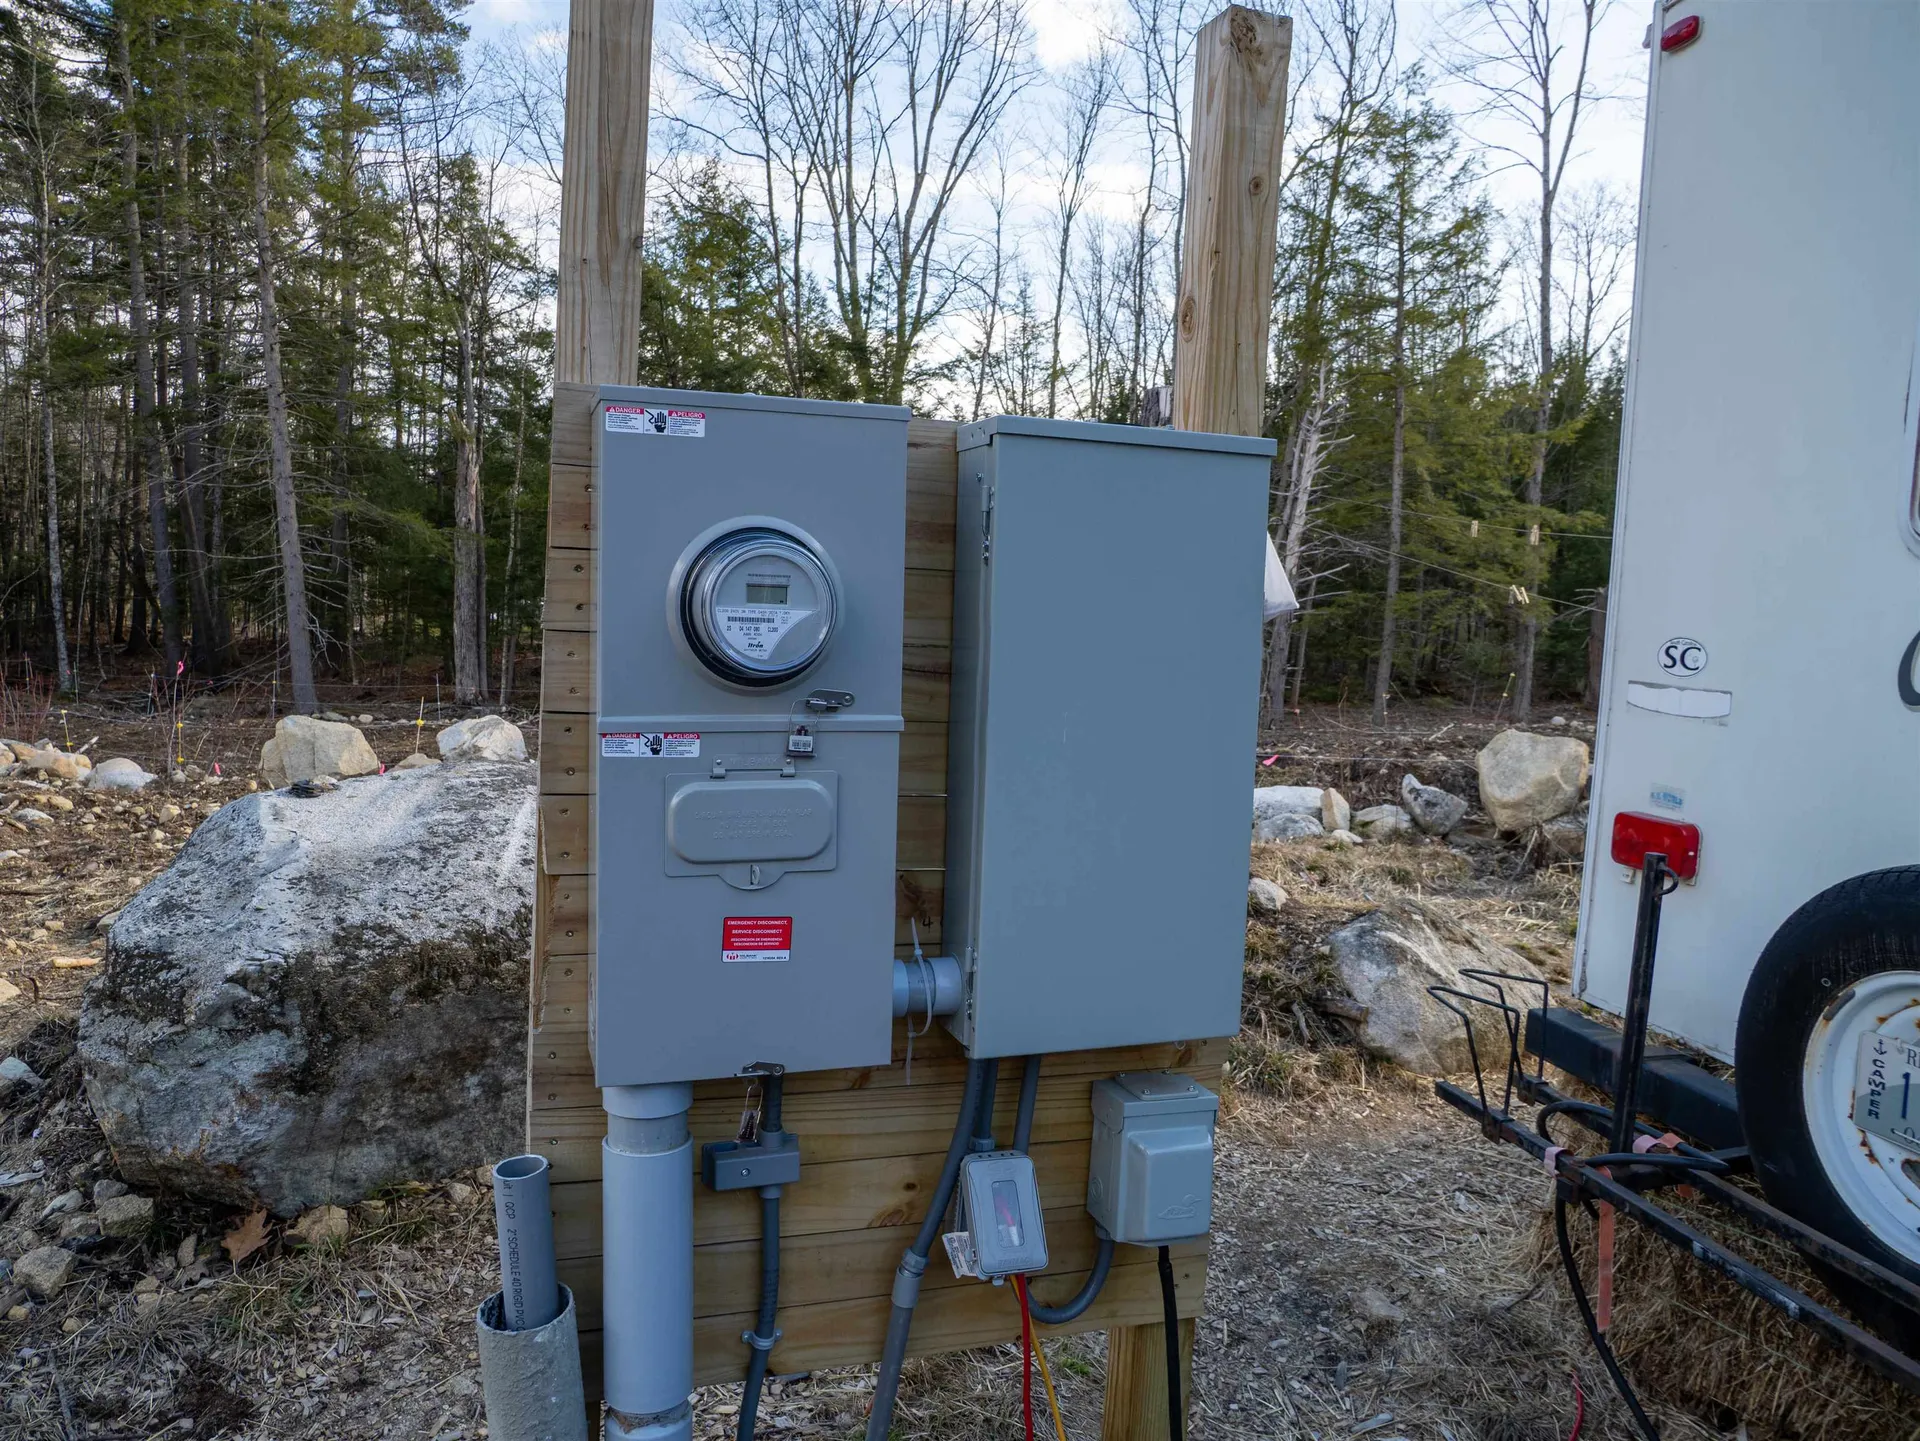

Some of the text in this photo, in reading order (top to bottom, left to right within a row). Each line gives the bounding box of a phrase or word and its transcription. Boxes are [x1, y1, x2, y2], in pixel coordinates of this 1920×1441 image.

[677, 411, 703, 419] PELIGRO
[1663, 645, 1702, 671] SC
[1867, 1058, 1886, 1120] CAMPER
[508, 1236, 521, 1277] SCHEDULE
[511, 1277, 522, 1288] 40
[513, 1288, 525, 1309] RIGID
[514, 1310, 526, 1326] PVC
